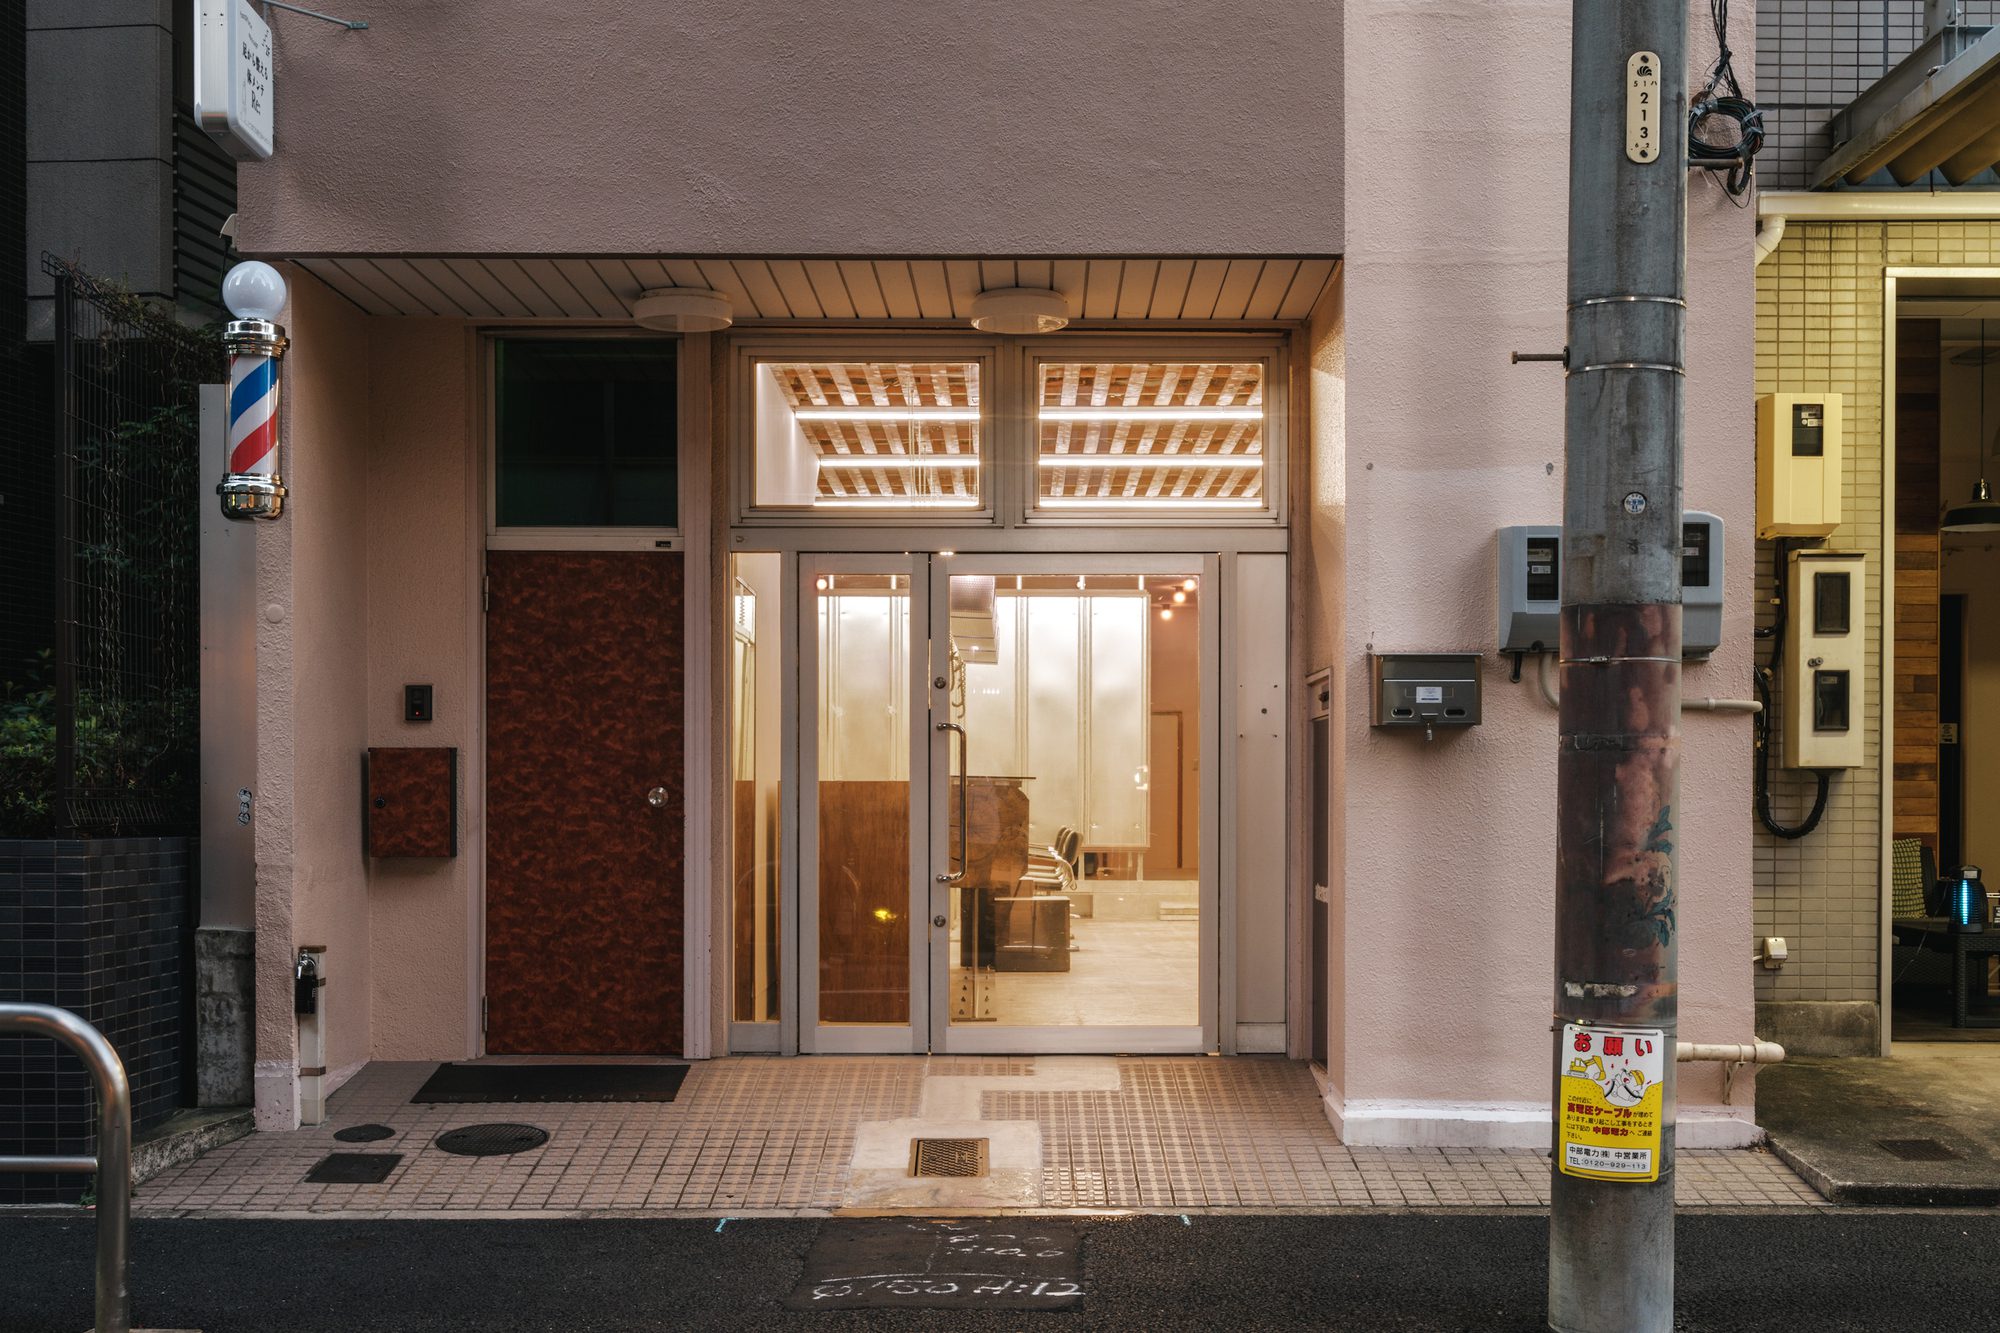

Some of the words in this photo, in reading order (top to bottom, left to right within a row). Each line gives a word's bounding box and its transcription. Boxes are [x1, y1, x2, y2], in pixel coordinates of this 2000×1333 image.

[1573, 1032, 1653, 1057] お願い
[1567, 1095, 1592, 1104] この付近に
